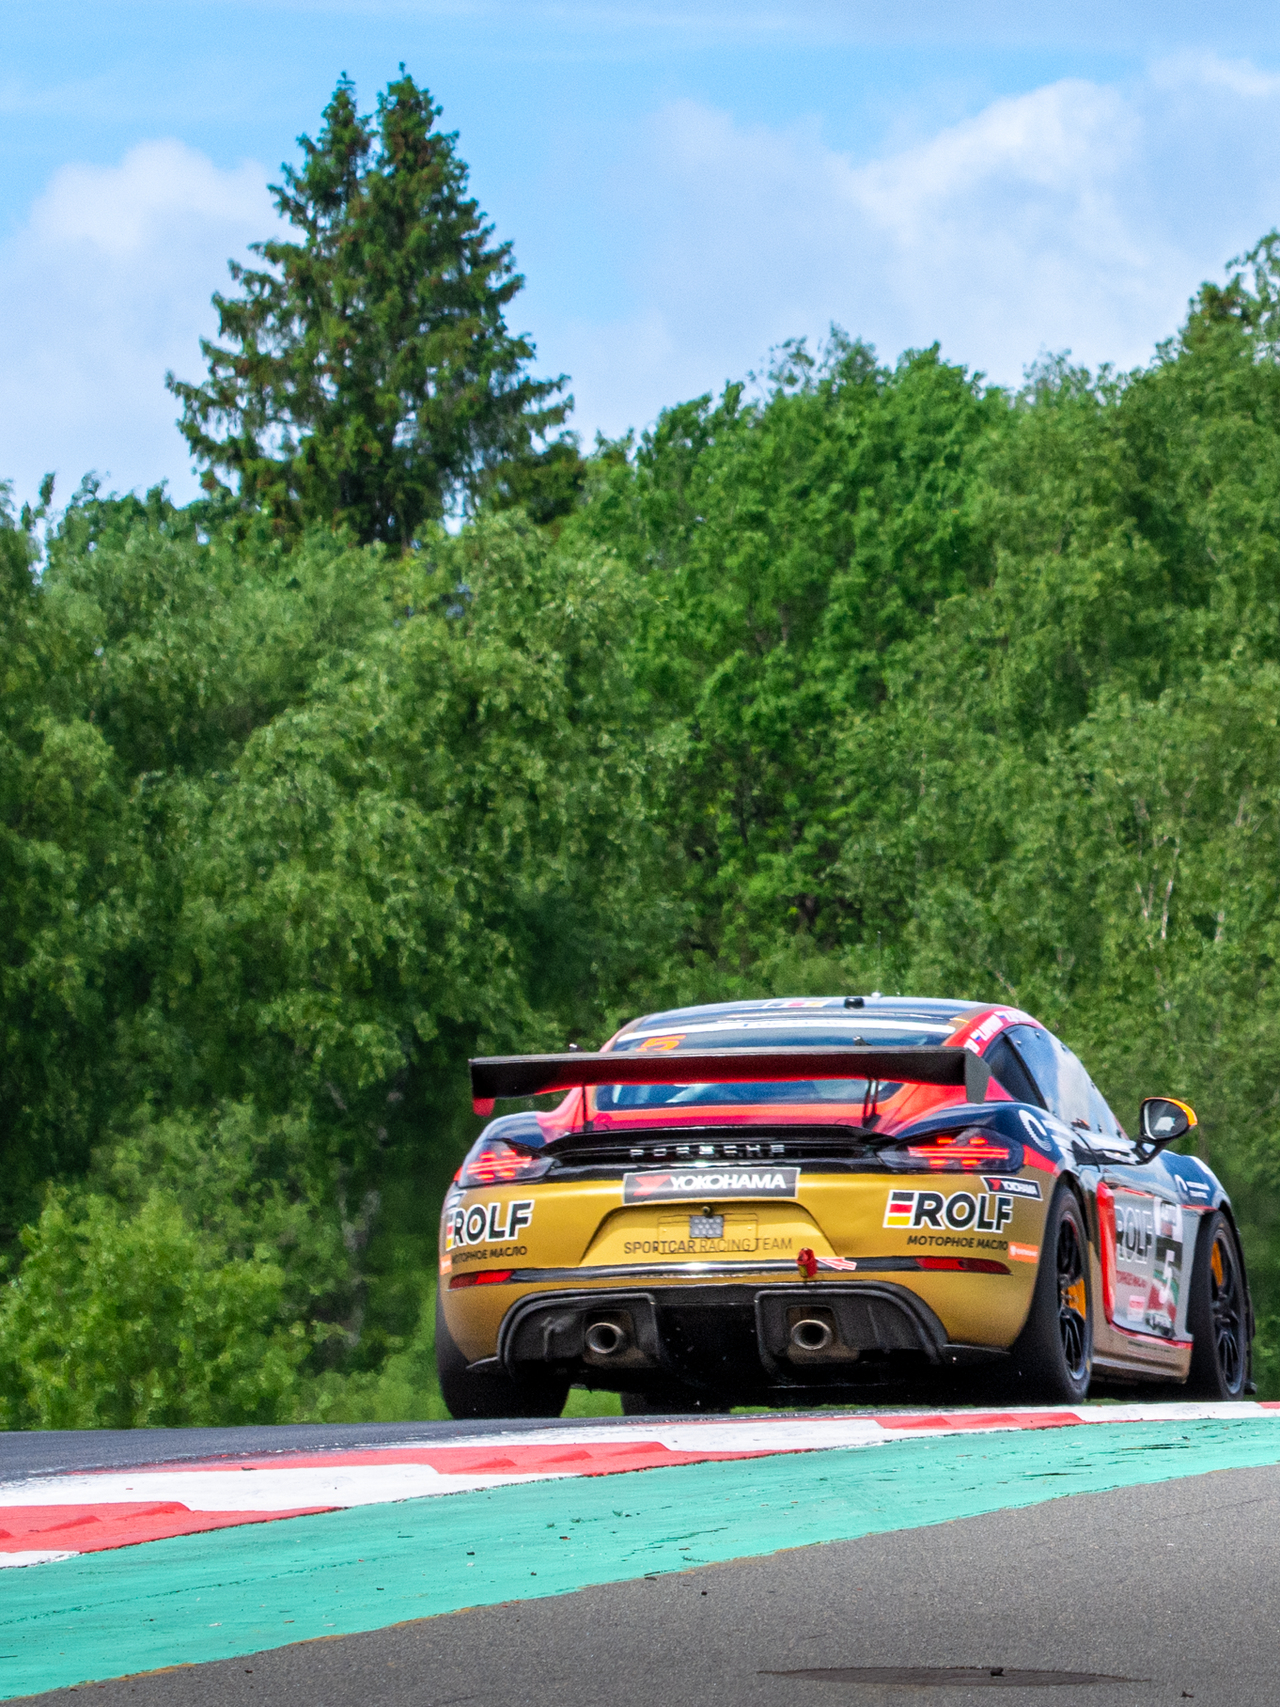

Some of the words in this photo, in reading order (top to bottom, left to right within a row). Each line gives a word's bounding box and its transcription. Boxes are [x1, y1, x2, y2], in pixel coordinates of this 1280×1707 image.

[629, 1144, 786, 1158] PORSCHE
[670, 1173, 787, 1190] YOKOHAMA
[911, 1190, 1014, 1233] ROLF
[451, 1199, 535, 1248] ROLF
[624, 1240, 697, 1255] SPORTCAR
[700, 1238, 750, 1252] RACING
[755, 1237, 793, 1250] TEAM
[907, 1235, 975, 1248] МОТОРНОЕ
